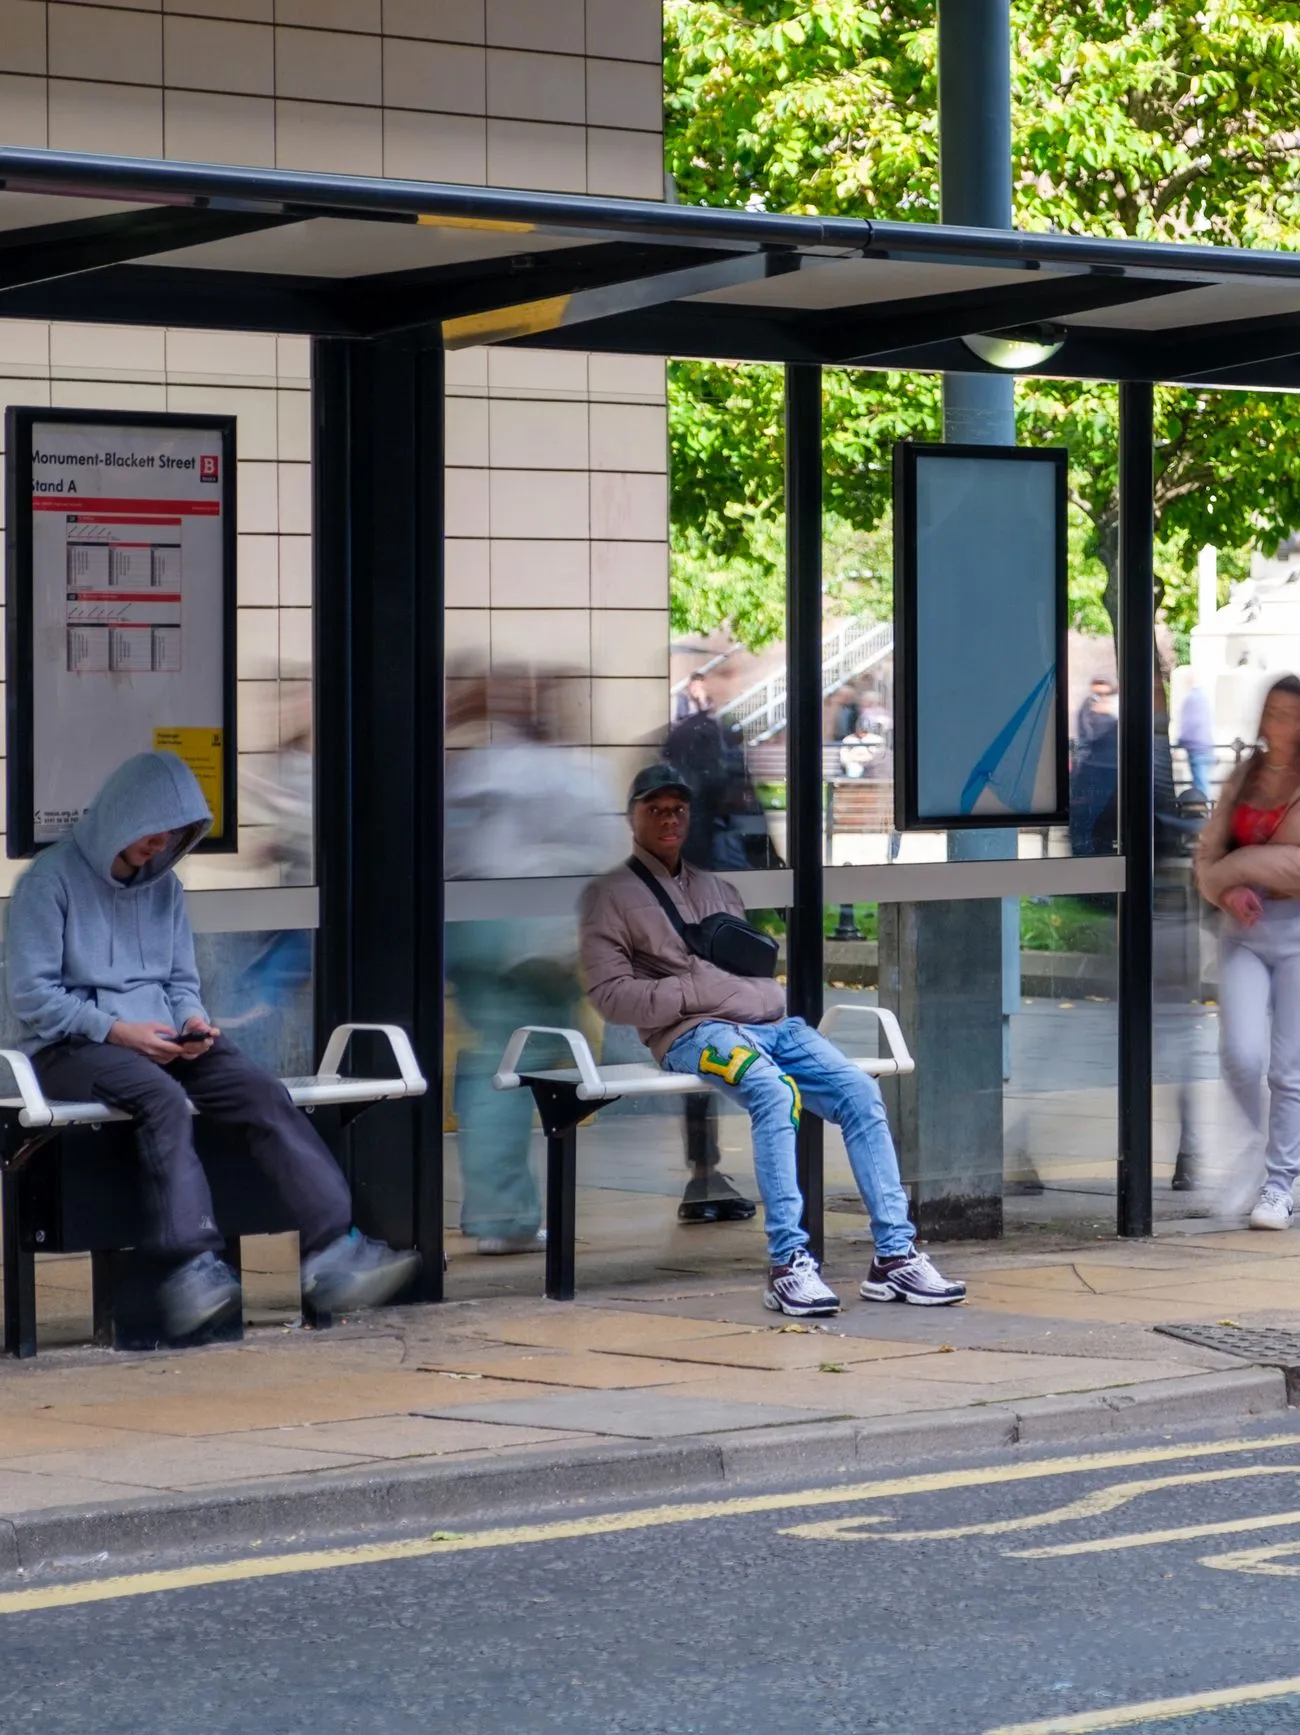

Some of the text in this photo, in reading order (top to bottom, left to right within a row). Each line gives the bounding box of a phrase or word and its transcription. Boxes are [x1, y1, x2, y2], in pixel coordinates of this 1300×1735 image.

[32, 450, 196, 470] Monument-Blackett Street
[203, 457, 215, 474] B
[67, 480, 77, 493] A
